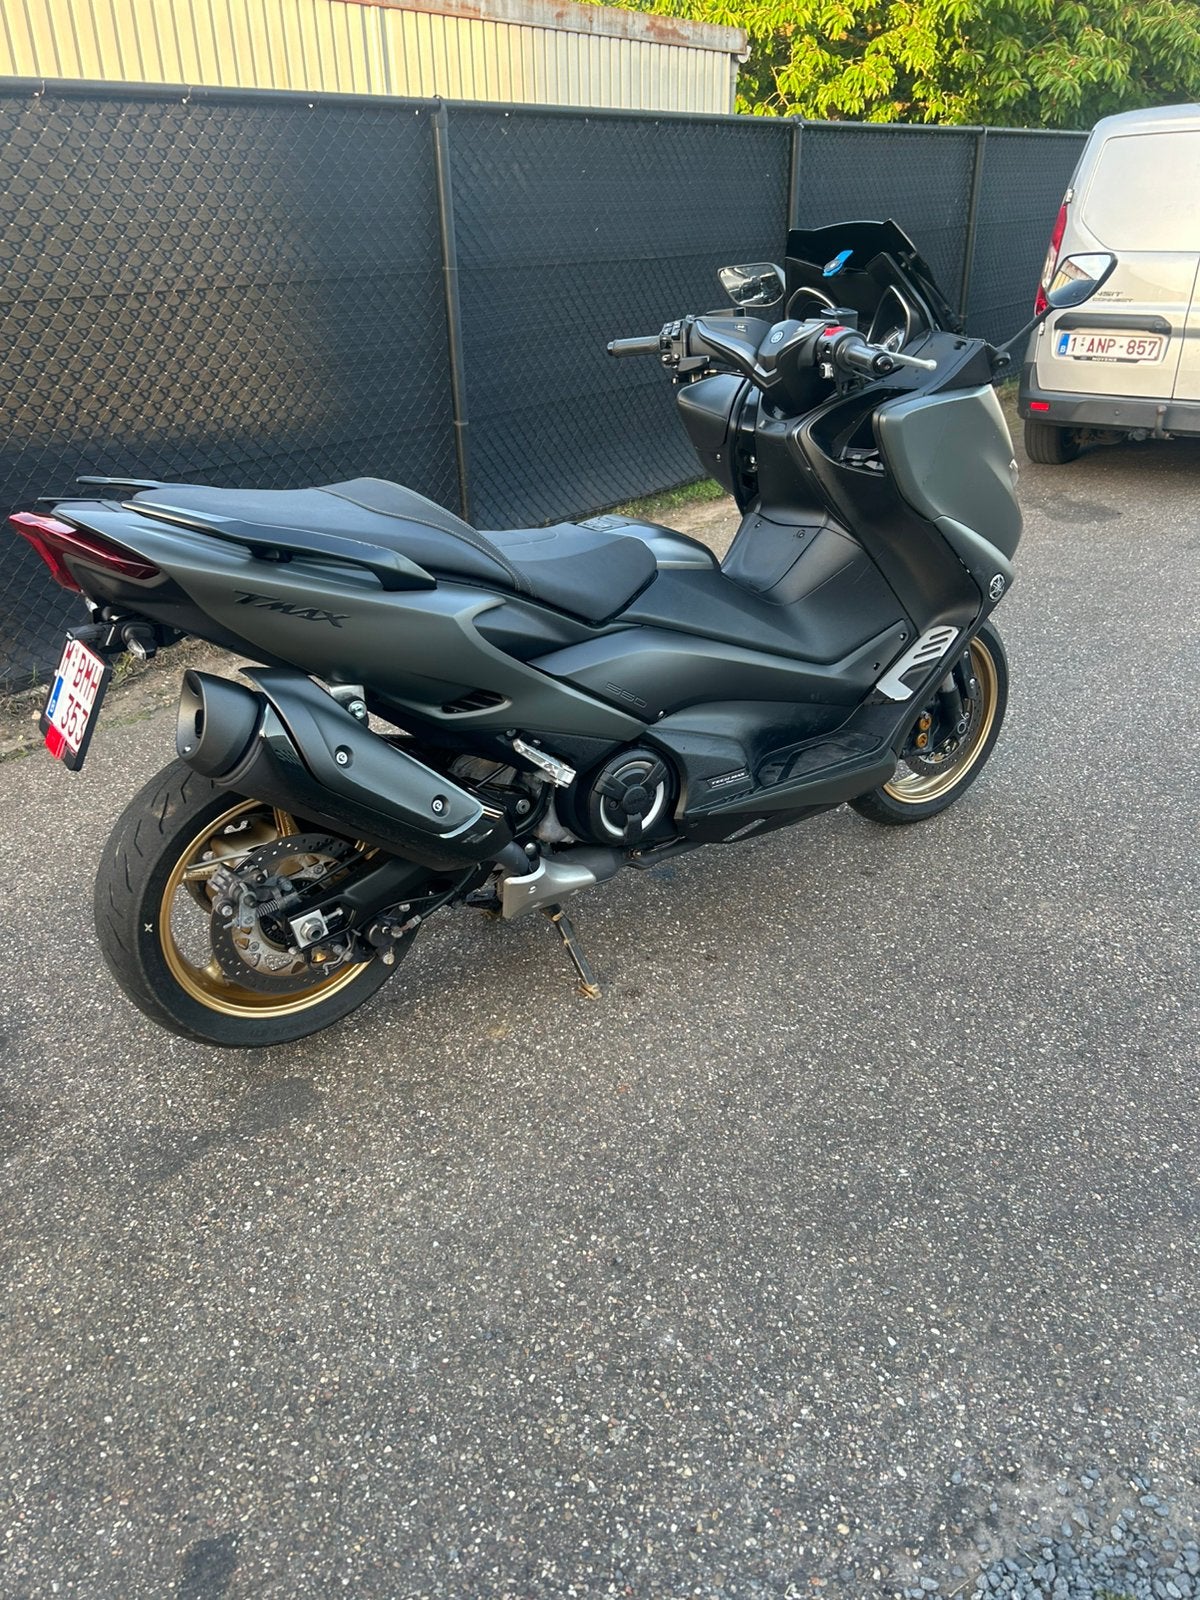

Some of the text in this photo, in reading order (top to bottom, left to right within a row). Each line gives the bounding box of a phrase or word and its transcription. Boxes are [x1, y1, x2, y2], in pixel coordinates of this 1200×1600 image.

[1070, 336, 1158, 356] 1-ANP-857
[233, 588, 351, 629] TMAX
[60, 642, 103, 704] M-BMH
[61, 693, 89, 745] 353
